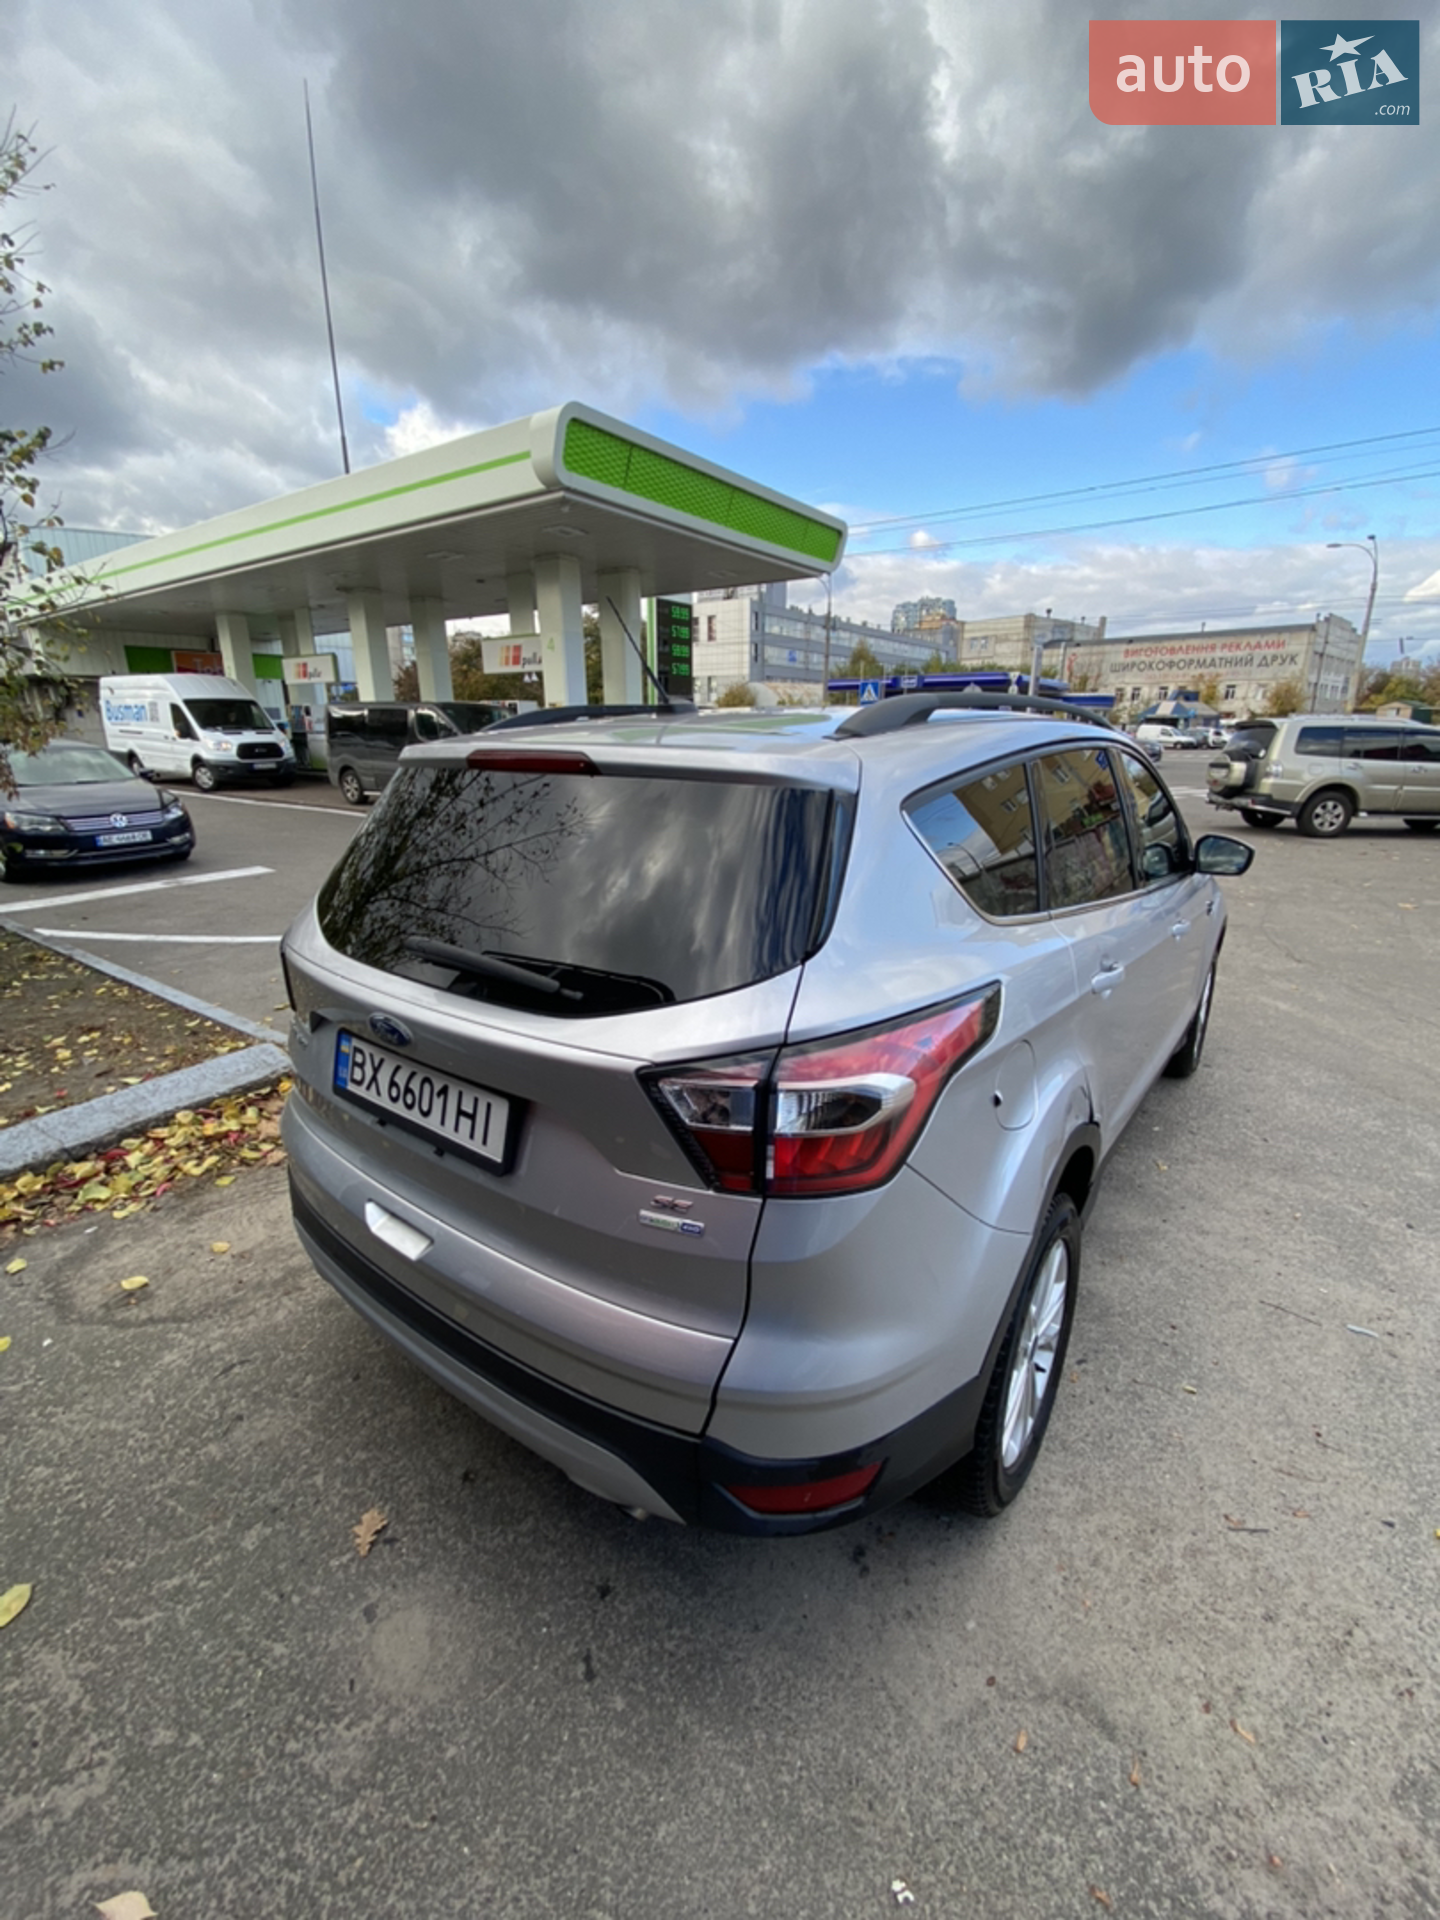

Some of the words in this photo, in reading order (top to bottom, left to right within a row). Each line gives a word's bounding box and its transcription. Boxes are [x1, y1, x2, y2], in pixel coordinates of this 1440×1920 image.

[1123, 642, 1216, 659] ВИГОТОВЛЕННЯ
[1221, 639, 1287, 653] РЕКЛАМИ
[1109, 653, 1254, 674] ШИРОКОФОРМАТНИЙ
[1256, 652, 1300, 668] ДРУК
[105, 700, 148, 722] Busman
